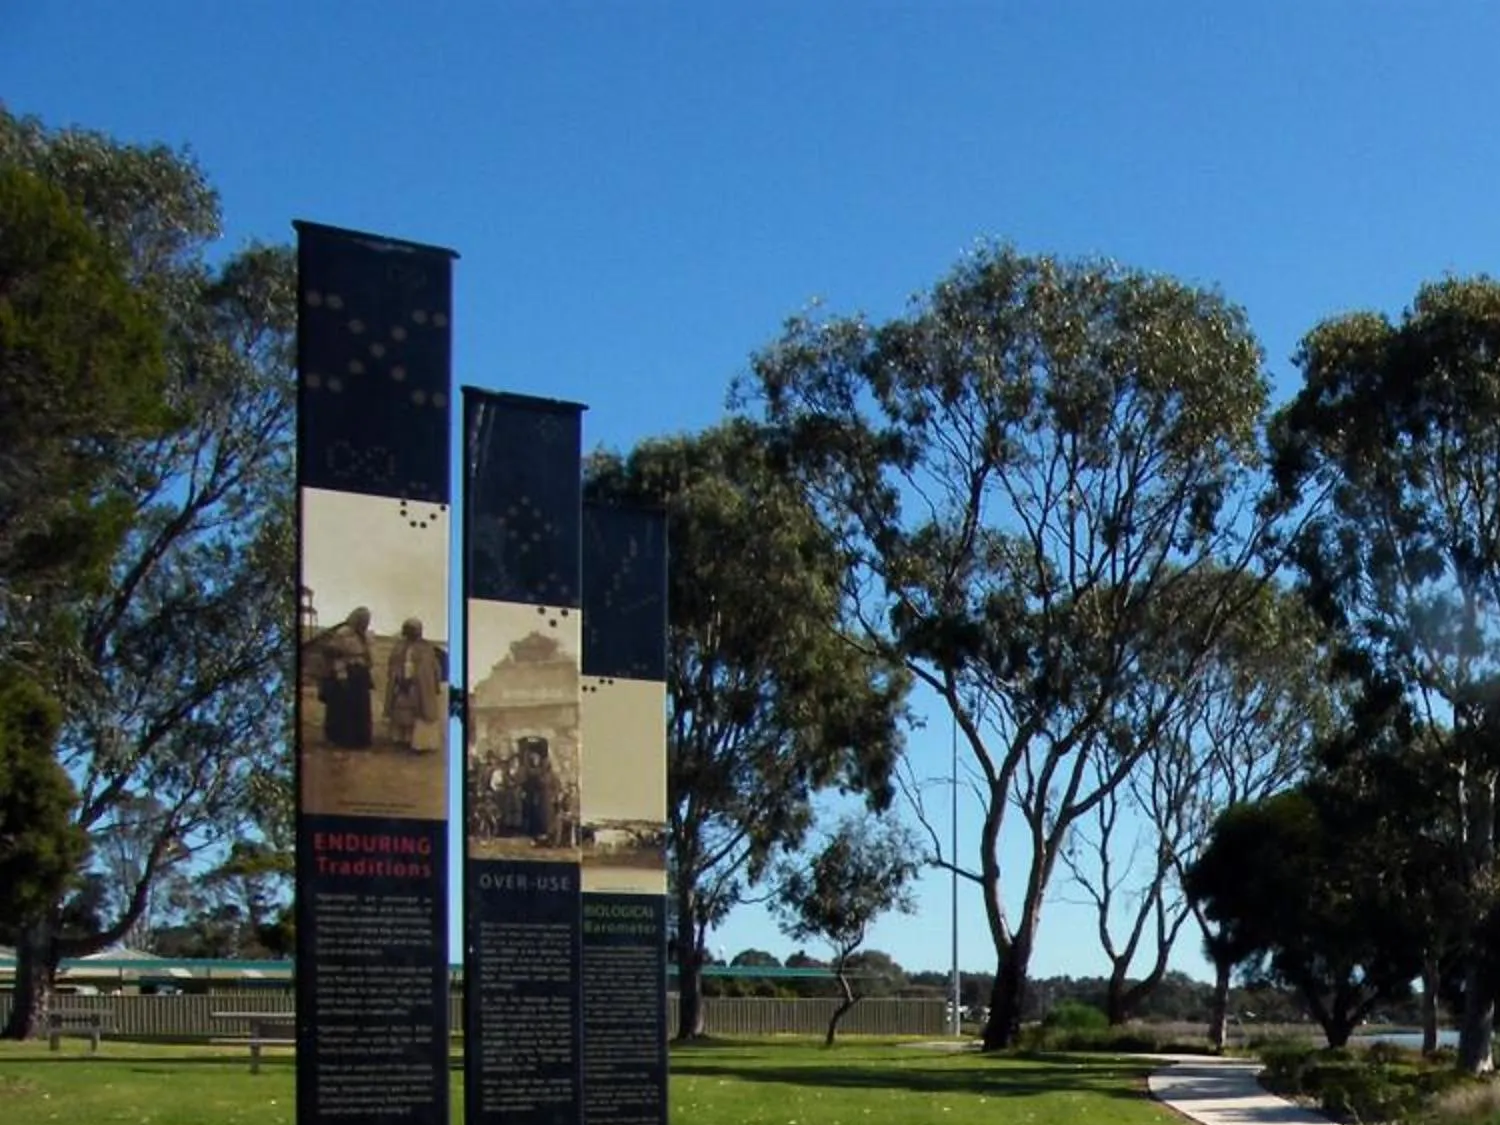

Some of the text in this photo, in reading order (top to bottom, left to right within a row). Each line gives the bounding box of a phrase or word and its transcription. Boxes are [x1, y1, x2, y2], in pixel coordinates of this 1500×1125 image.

[313, 832, 432, 855] ENDURING
[316, 856, 433, 879] Traditions
[479, 873, 572, 892] OVER-USE
